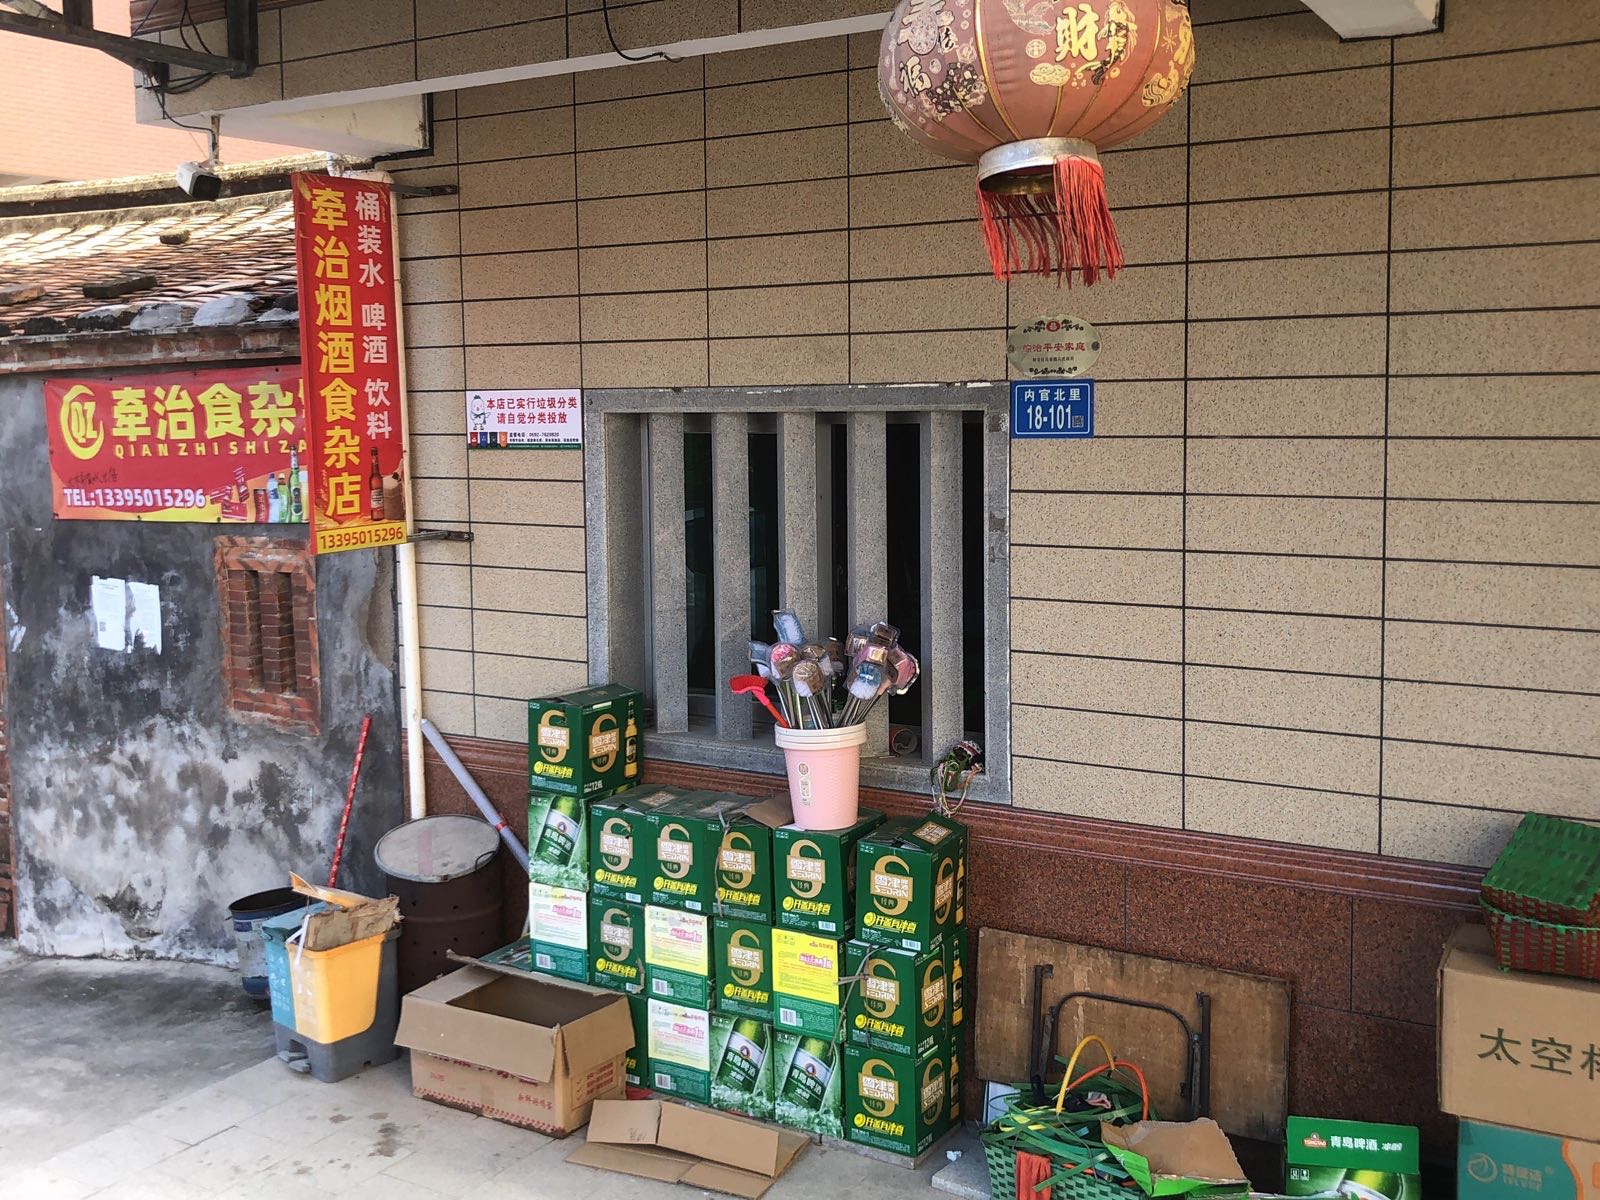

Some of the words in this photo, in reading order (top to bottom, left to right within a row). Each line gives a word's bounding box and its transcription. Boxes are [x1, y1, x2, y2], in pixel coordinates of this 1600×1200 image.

[354, 191, 386, 288] 桶装水
[361, 303, 388, 364] 啤酒
[311, 187, 361, 518] 牵治烟酒食杂店
[486, 396, 577, 410] 本店已实行垃圾分类
[1024, 388, 1081, 402] 内官北里
[364, 378, 393, 440] 饮料
[497, 411, 567, 424] 请自觉分类投放
[1026, 404, 1072, 430] 18-101
[63, 488, 206, 508] TEL:13395015296
[319, 525, 405, 549] 13395015296
[874, 884, 909, 898] SEDRIN
